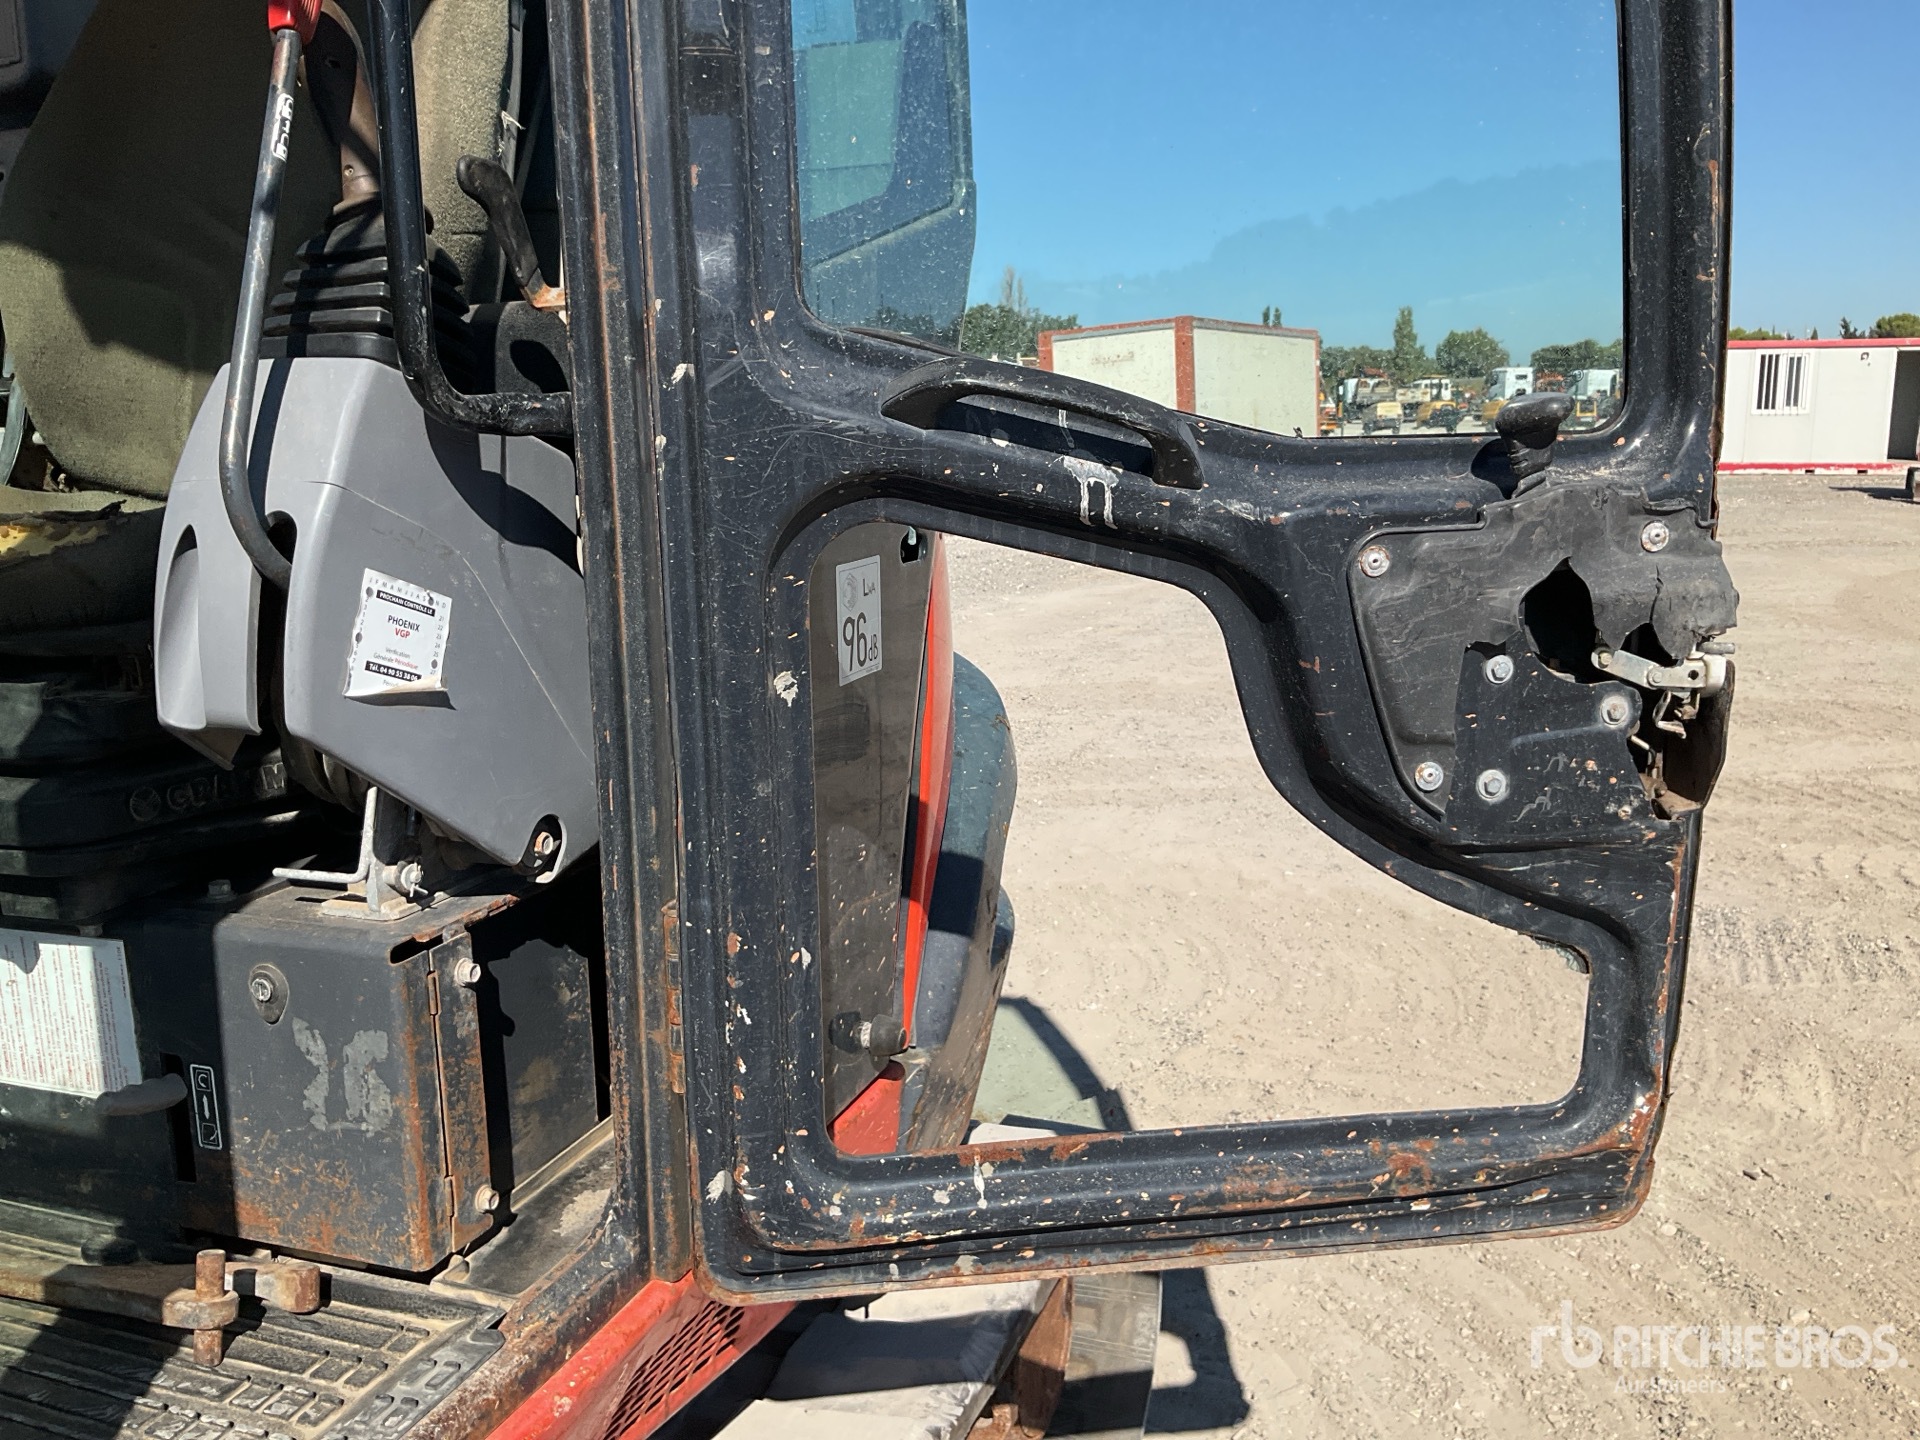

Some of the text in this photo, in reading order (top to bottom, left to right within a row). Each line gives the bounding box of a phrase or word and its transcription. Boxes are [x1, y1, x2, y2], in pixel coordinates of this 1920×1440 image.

[387, 614, 421, 632] PHOENIX
[394, 627, 411, 639] VGP
[842, 611, 879, 671] 96 dB
